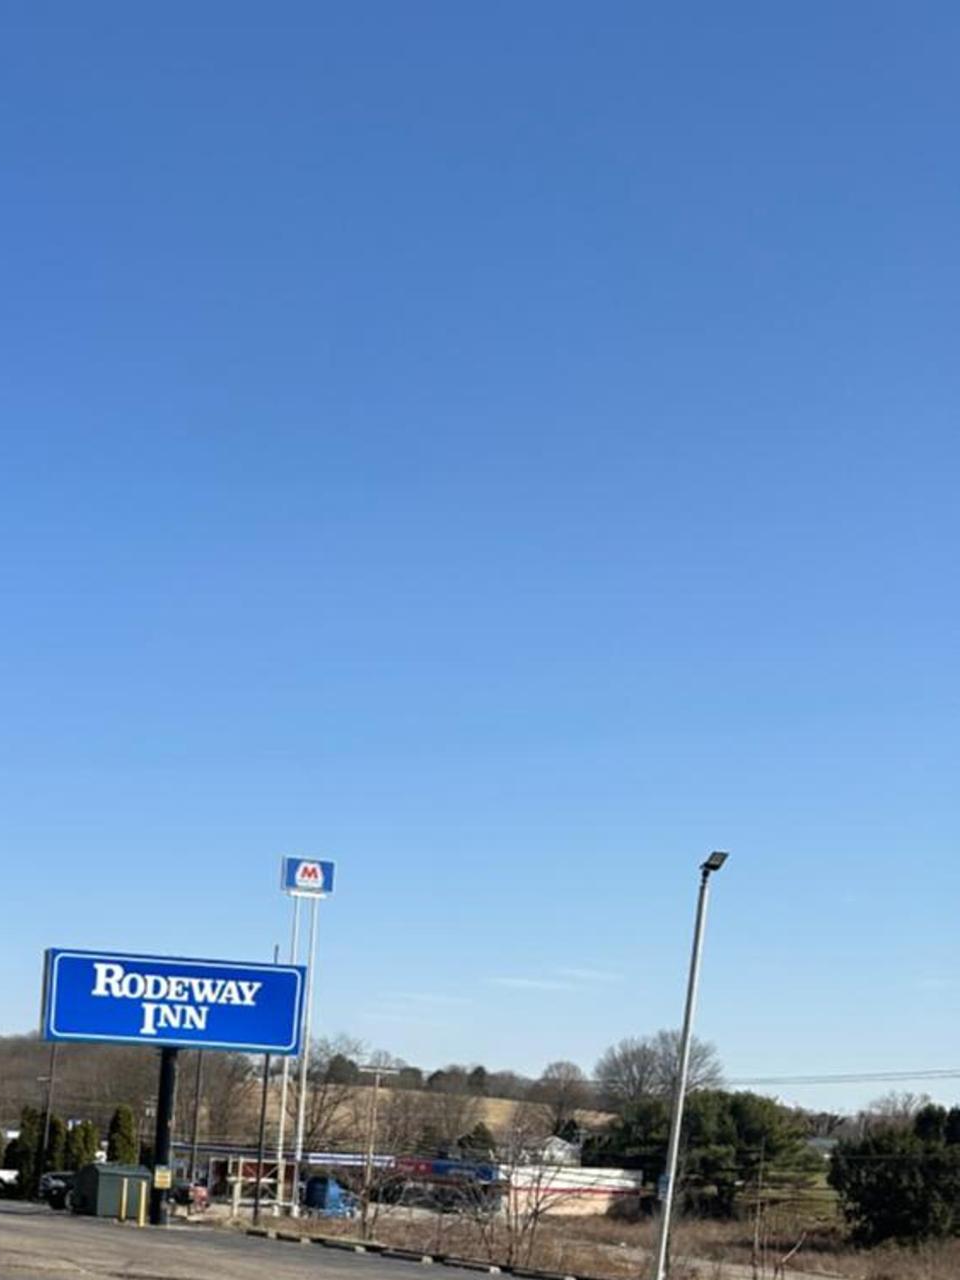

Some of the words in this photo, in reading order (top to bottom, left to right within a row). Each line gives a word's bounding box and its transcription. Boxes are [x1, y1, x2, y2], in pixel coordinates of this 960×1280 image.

[300, 866, 318, 879] M
[91, 962, 263, 1007] RODEWAY
[140, 1002, 209, 1035] INN
